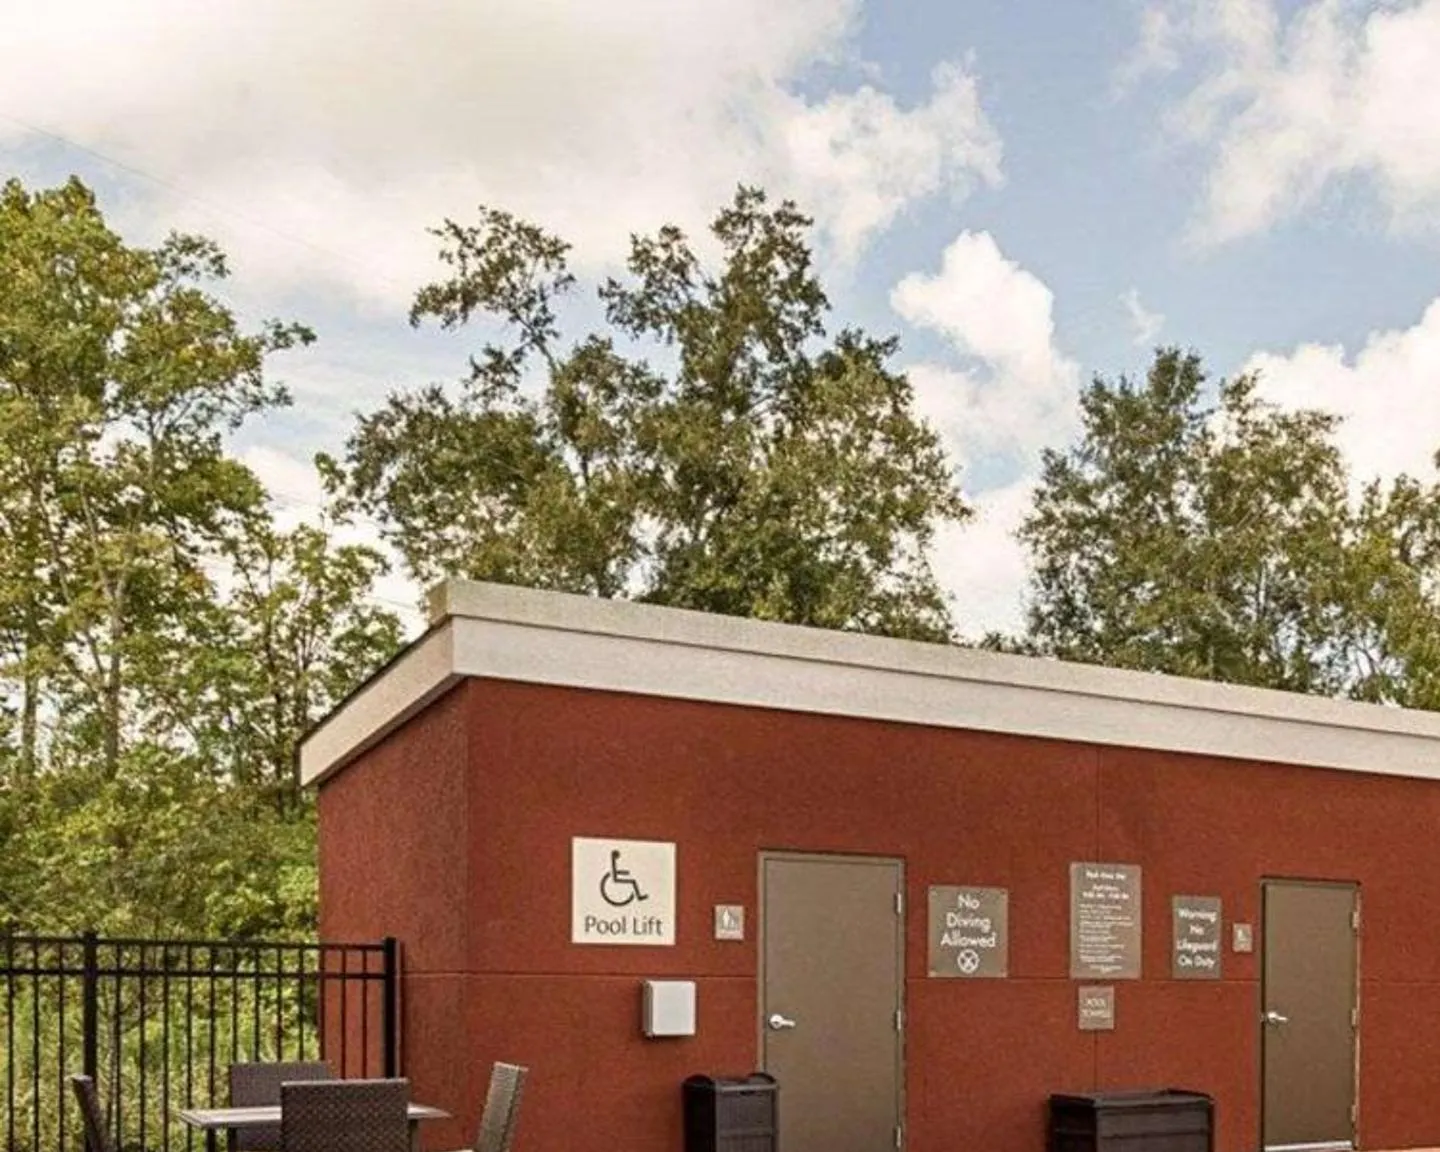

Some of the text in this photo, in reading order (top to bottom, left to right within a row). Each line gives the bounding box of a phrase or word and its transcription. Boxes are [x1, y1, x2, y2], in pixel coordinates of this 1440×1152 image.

[958, 894, 980, 909] No
[585, 915, 663, 936] Pool Lift
[946, 911, 991, 933] Diving
[941, 929, 996, 947] Allowed
